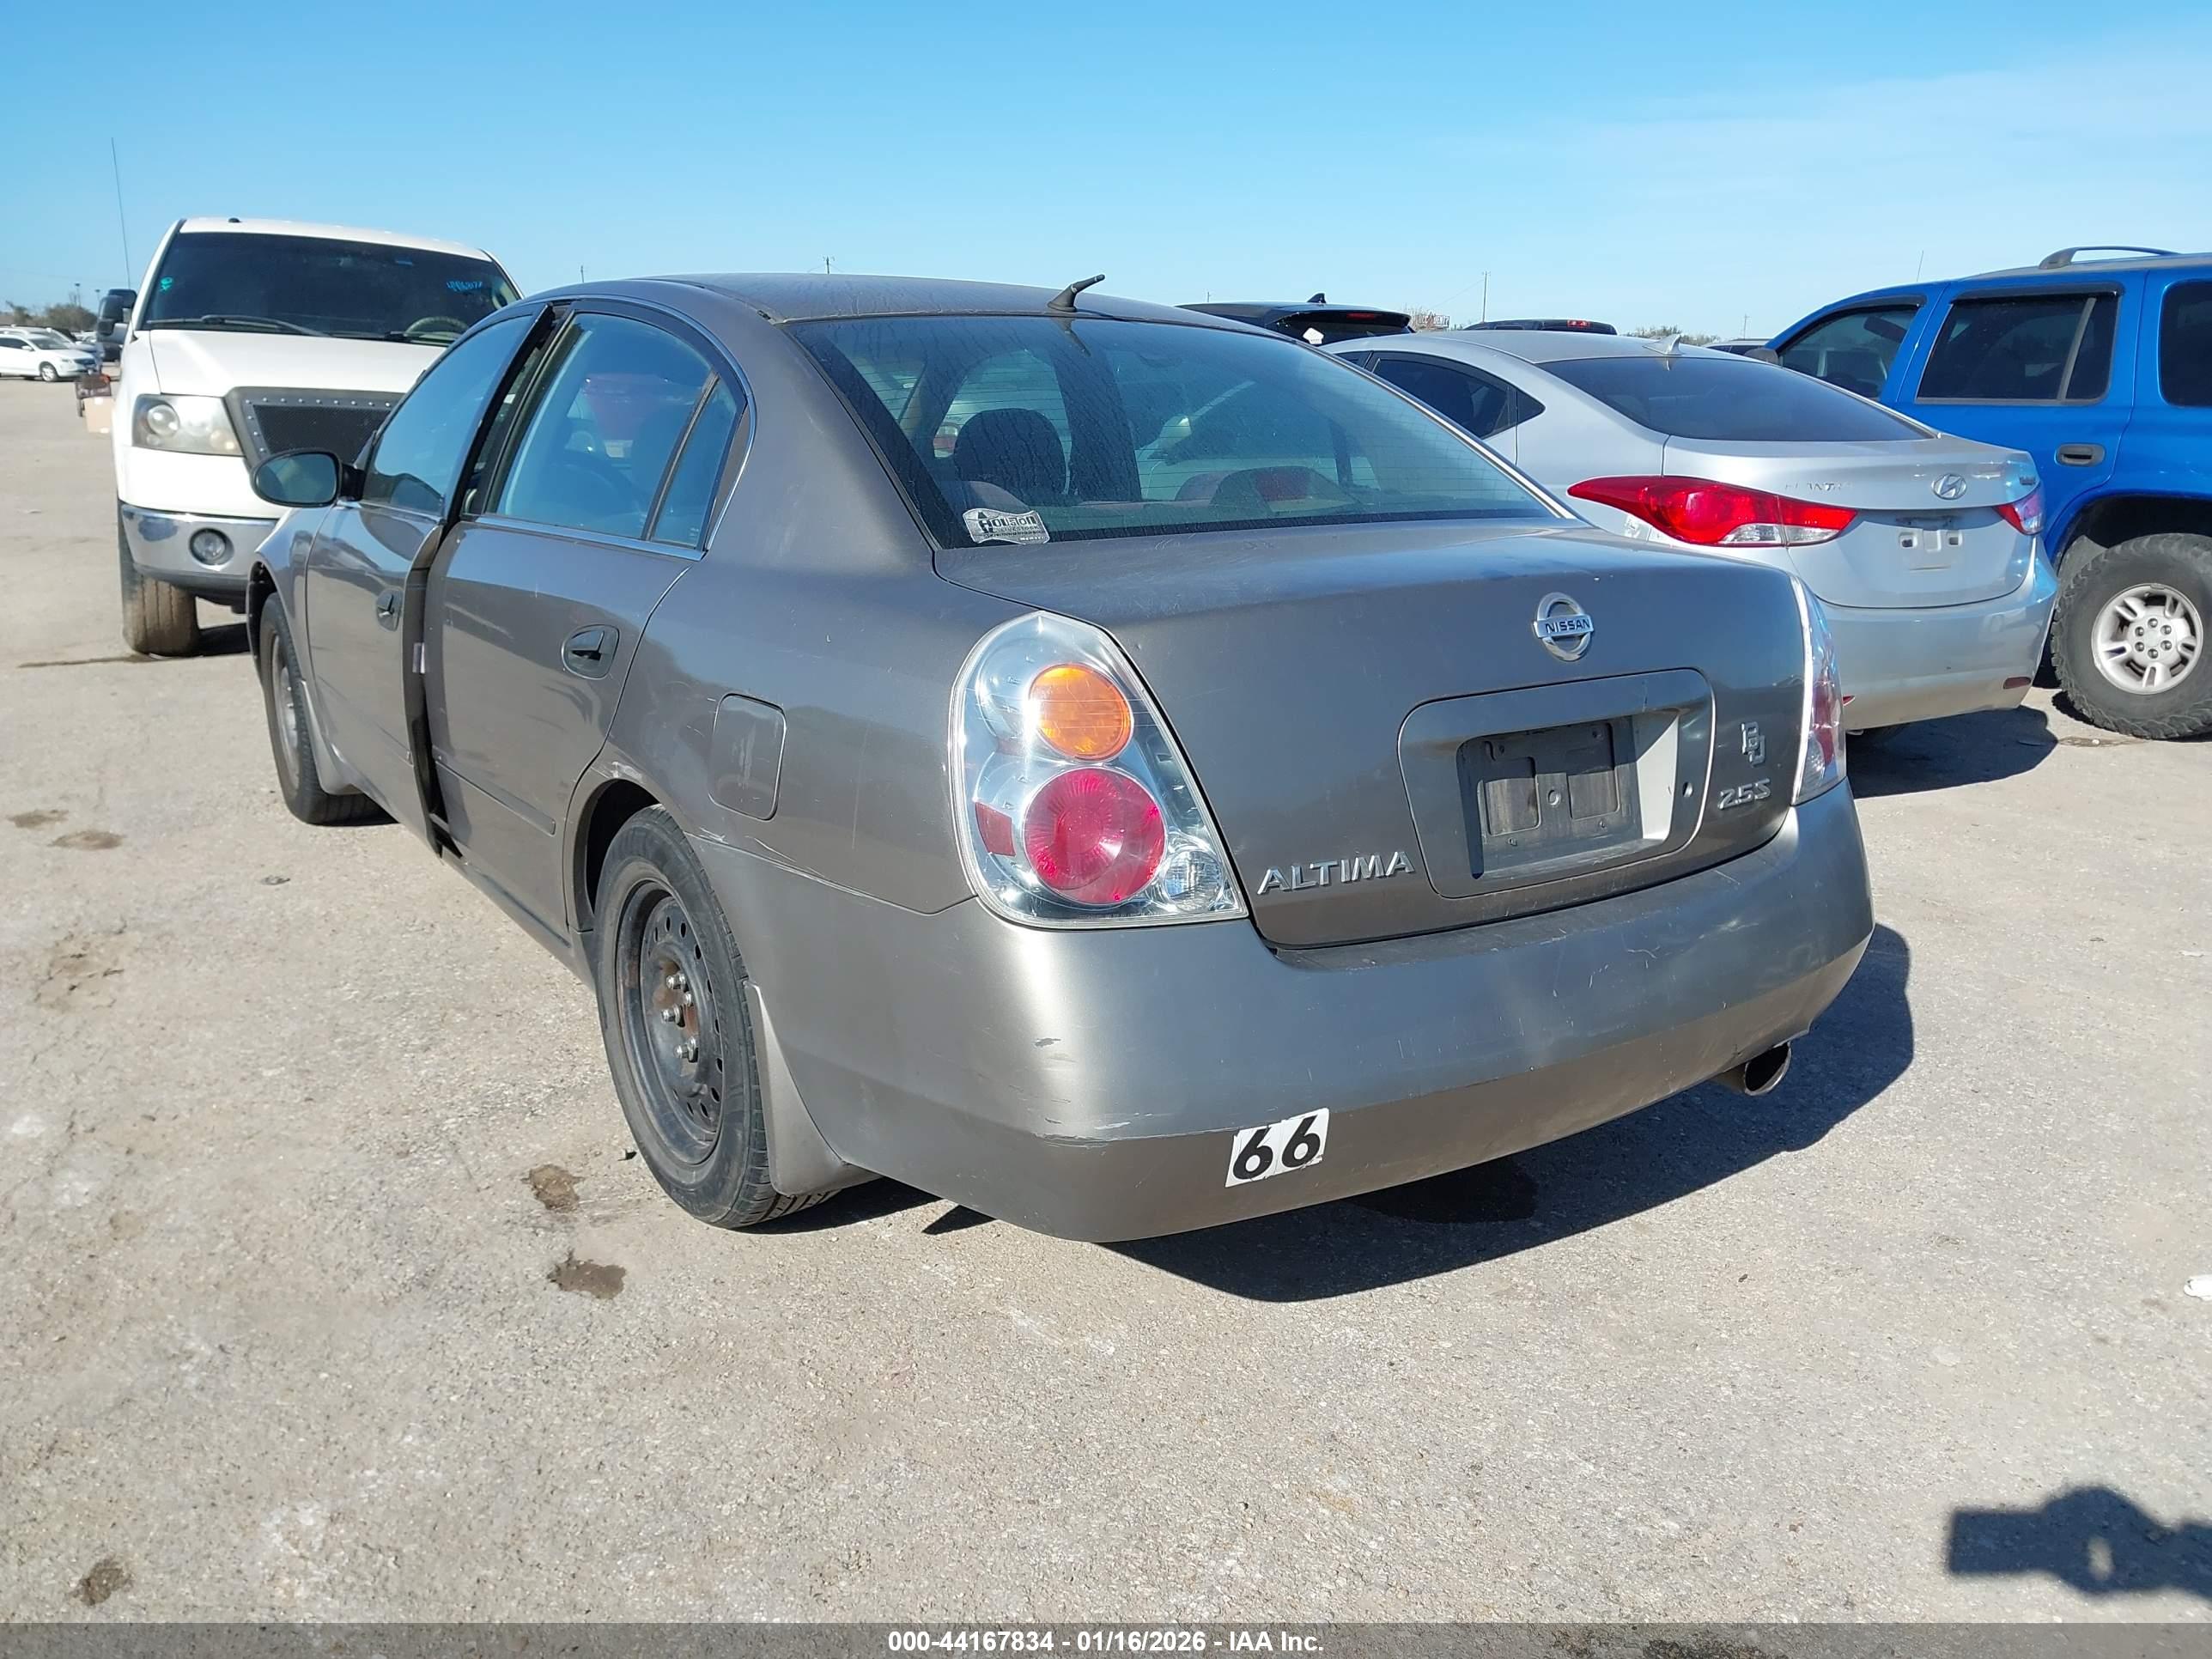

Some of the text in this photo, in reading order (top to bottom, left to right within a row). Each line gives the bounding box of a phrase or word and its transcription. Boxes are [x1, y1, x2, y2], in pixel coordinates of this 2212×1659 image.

[1545, 618, 1590, 633] NISSAN
[1256, 851, 1415, 895] ALTIMA
[1233, 1115, 1322, 1180] 66
